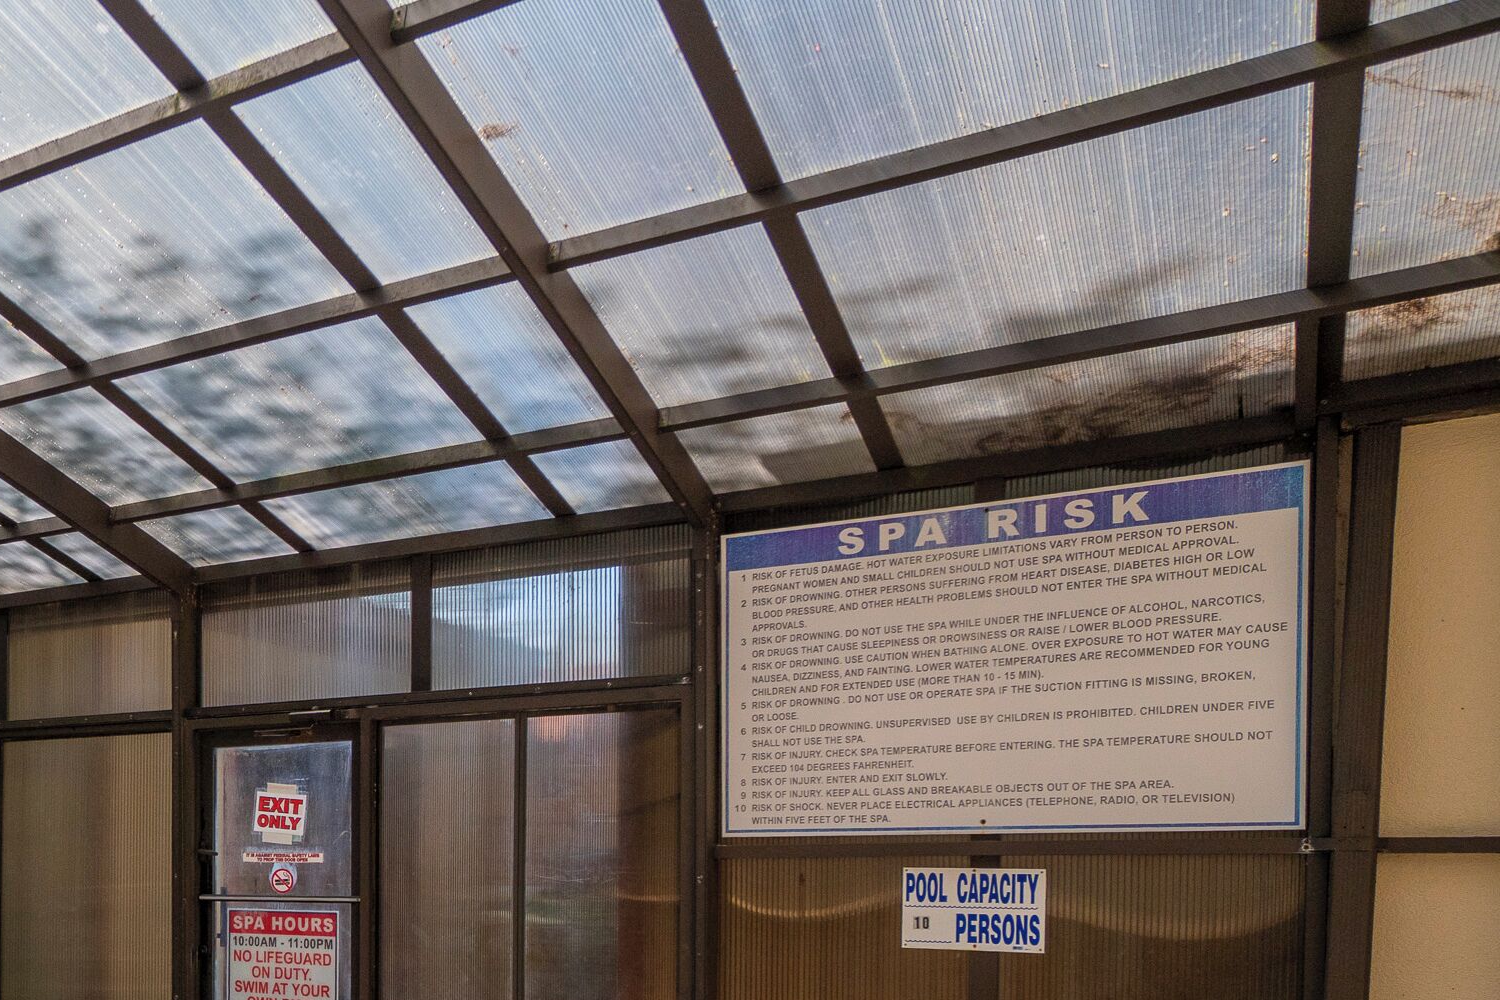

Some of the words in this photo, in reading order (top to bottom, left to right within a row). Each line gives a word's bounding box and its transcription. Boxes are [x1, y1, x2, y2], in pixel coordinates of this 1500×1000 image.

[837, 517, 946, 555] SPA
[988, 491, 1151, 539] RISK
[741, 574, 746, 582] 1
[751, 570, 773, 581] RISK
[774, 569, 787, 579] OF
[789, 565, 819, 577] FETUS
[866, 558, 886, 569] HOT
[888, 554, 922, 567] WATER
[924, 548, 980, 563] EXPOSURE
[982, 540, 1047, 557] LIMITATIONS
[1048, 537, 1078, 549] VARY
[1080, 533, 1112, 546] FROM
[1115, 527, 1163, 542] PERSON
[1165, 525, 1182, 537] TO
[1182, 519, 1238, 535] PERSON.
[751, 580, 801, 594] PREGNANT
[802, 576, 838, 589] WOMEN
[839, 575, 860, 585] AND
[862, 571, 895, 583] SMALL
[896, 565, 946, 580] CHILDREN
[948, 561, 991, 574] SHOULD
[993, 558, 1015, 569] NOT
[1017, 555, 1039, 567] USE
[1041, 553, 1063, 565] SPA
[1064, 547, 1115, 562] WITHOUT
[1118, 541, 1170, 556] MEDICAL
[1171, 534, 1239, 551] APPROVAL.
[751, 608, 783, 620] BLOOD
[785, 603, 836, 617] PRESSURE,
[838, 601, 858, 612] AND
[860, 598, 894, 610] OTHER
[895, 594, 934, 606] HEALTH
[936, 588, 992, 603] PROBLEMS
[995, 584, 1038, 597] SHOULD
[1041, 582, 1064, 593] NOT
[1066, 578, 1103, 591] ENTER
[1105, 575, 1128, 587] THE
[1130, 573, 1153, 585] SPA
[1155, 567, 1209, 582] WITHOUT
[1212, 562, 1267, 576] MEDICAL
[792, 669, 842, 681] DIZZINESS,
[843, 667, 864, 677] AND
[866, 664, 913, 676] FAINTING.
[915, 661, 952, 672] LOWER
[953, 658, 989, 670] WATER
[991, 652, 1077, 667] TEMPERATURES
[1078, 650, 1104, 661] ARE
[1104, 643, 1195, 659] RECOMMENDED
[1198, 641, 1224, 653] FOR
[1225, 638, 1270, 651] YOUNG
[751, 738, 780, 748] SHALL
[782, 737, 801, 746] NOT
[803, 736, 822, 745] USE
[824, 735, 843, 744] THE
[844, 734, 865, 743] SPA.
[751, 764, 787, 774] EXCEED
[789, 763, 804, 772] 104
[806, 761, 850, 772] DEGREES
[852, 759, 914, 770] FAHRENHEIT.
[740, 778, 746, 786] 8
[751, 777, 772, 786] RISK
[774, 777, 787, 786] OF
[826, 774, 857, 784] ENTER
[858, 774, 879, 783] AND
[881, 773, 903, 782] EXIT
[905, 771, 947, 782] SLOWLY.
[258, 796, 303, 815] EXIT
[257, 814, 301, 830] ONLY
[751, 816, 782, 824] WITHIN
[785, 815, 805, 824] FIVE
[807, 815, 831, 824] FEET
[832, 814, 846, 823] OF
[848, 814, 867, 823] THE
[869, 814, 891, 823] SPA.
[905, 872, 948, 903] POOL
[957, 872, 1039, 904] CAPACITY
[233, 915, 265, 930] SPA
[271, 916, 334, 932] HOURS
[914, 916, 929, 930] 10
[955, 913, 1040, 946] PERSONS
[232, 936, 277, 948] 10:00AM
[288, 938, 333, 950] 11:00PM
[233, 950, 252, 962] NO
[255, 951, 332, 966] LIFEGUARD
[251, 966, 270, 979] ON
[274, 967, 312, 981] DUTY.
[234, 980, 269, 995] SWIM
[272, 982, 289, 995] AT
[292, 984, 330, 998] YOUR
